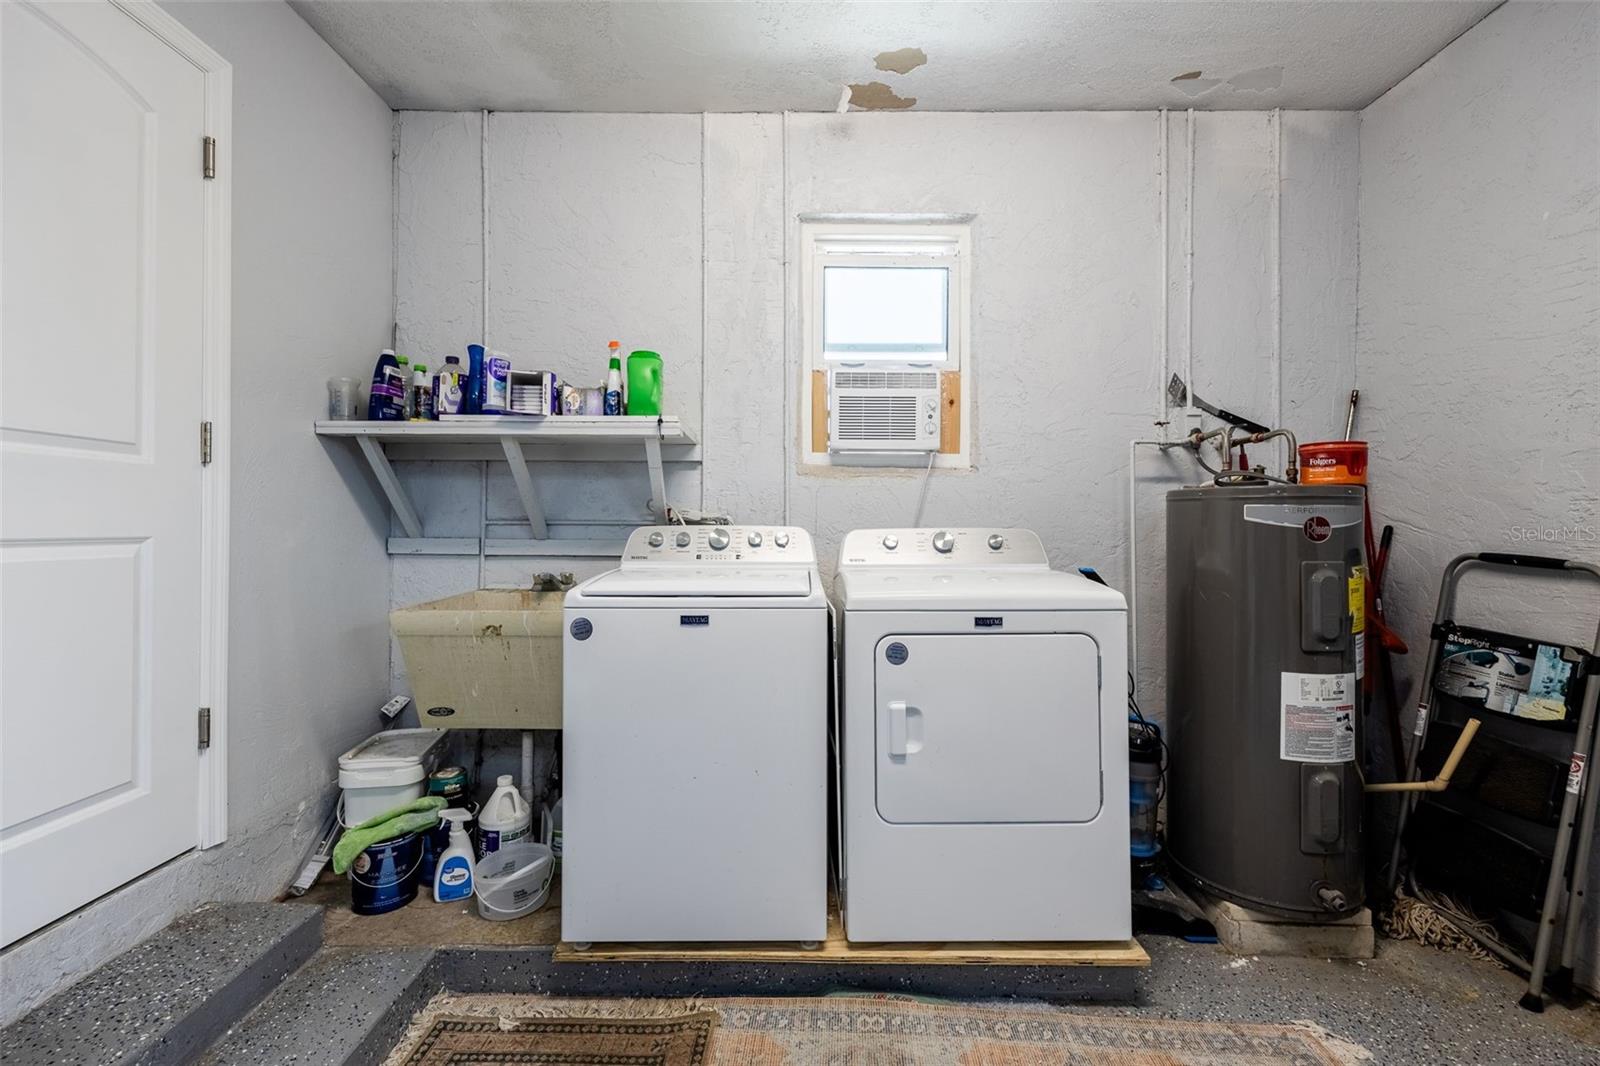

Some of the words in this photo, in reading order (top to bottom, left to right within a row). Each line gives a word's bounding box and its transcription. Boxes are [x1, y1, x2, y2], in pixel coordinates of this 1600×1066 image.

[1309, 458, 1337, 467] Folgers
[1307, 518, 1330, 538] Rheem
[1447, 633, 1491, 649] StepRight
